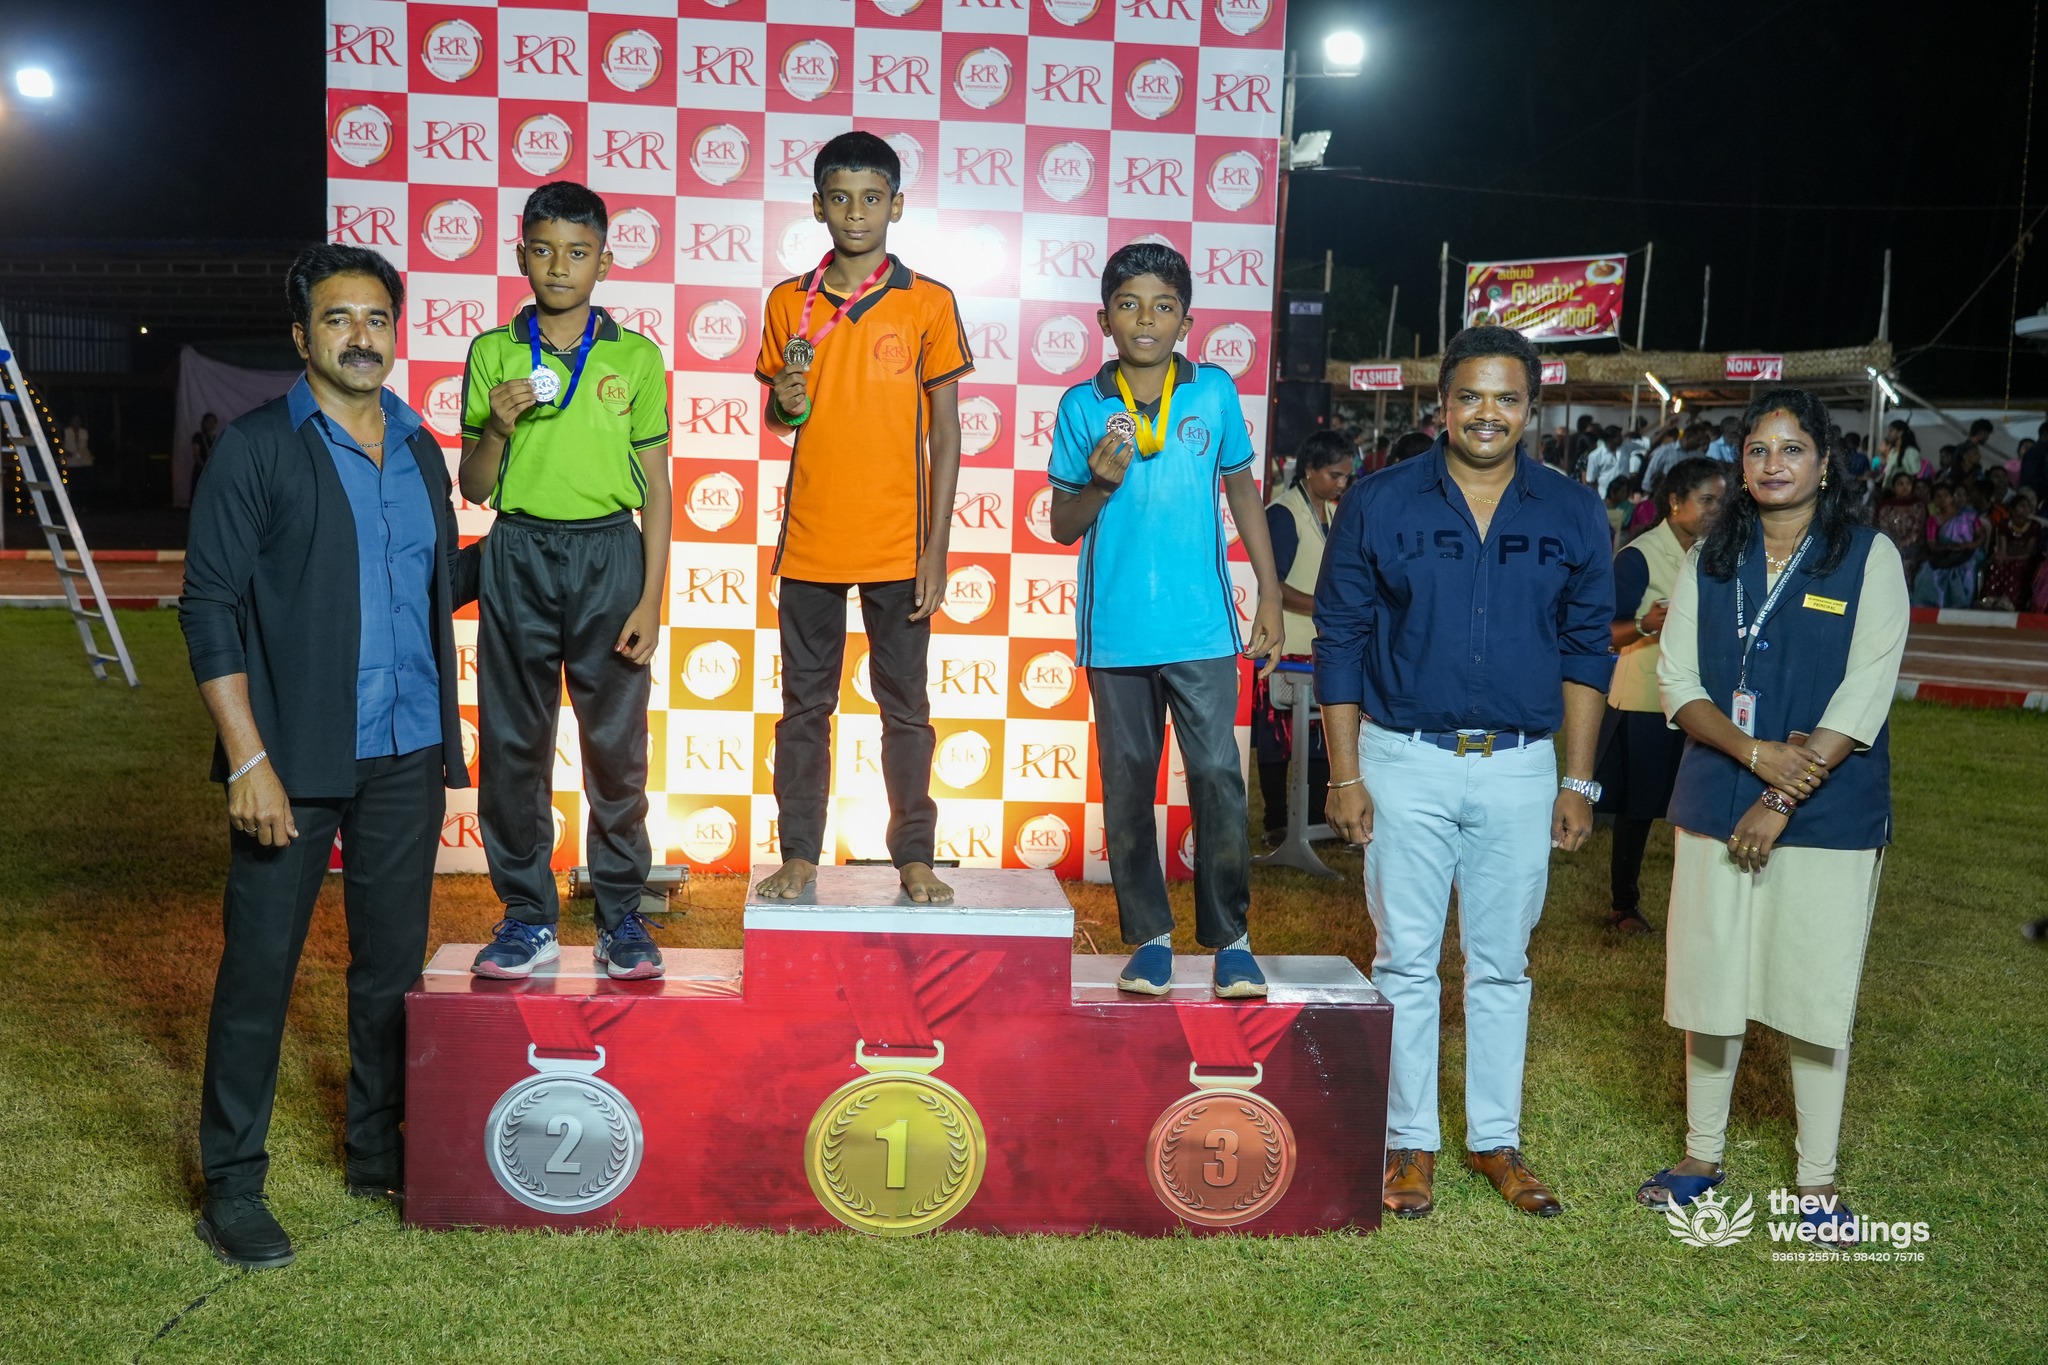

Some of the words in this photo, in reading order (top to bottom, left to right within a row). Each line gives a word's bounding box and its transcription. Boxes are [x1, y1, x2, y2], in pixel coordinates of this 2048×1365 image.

[326, 23, 402, 66] RR
[433, 35, 469, 56] RR
[504, 33, 582, 76] RR
[613, 45, 649, 65] RR
[683, 44, 760, 86] RR
[791, 55, 826, 75] RR
[859, 53, 936, 95] RR
[965, 63, 1000, 83] RR
[1032, 62, 1108, 104] RR
[1136, 74, 1171, 94] RR
[1202, 72, 1277, 113] RR
[343, 120, 379, 140] RR
[414, 119, 492, 162] RR
[524, 130, 559, 150] RR
[593, 128, 671, 170] RR
[943, 145, 1019, 187] RR
[1114, 156, 1189, 197] RR
[434, 215, 469, 234] RR
[681, 222, 758, 263] RR
[1195, 246, 1270, 287] RR
[414, 297, 492, 338] RR
[1355, 370, 1400, 385] CASHIER
[678, 396, 754, 436] RR
[676, 566, 751, 605] RR
[1756, 610, 1768, 624] RR
[928, 658, 1002, 695] RR
[1009, 742, 1082, 779] RR
[546, 1114, 584, 1174] 2
[875, 1120, 908, 1189] 1
[1203, 1129, 1239, 1186] 3
